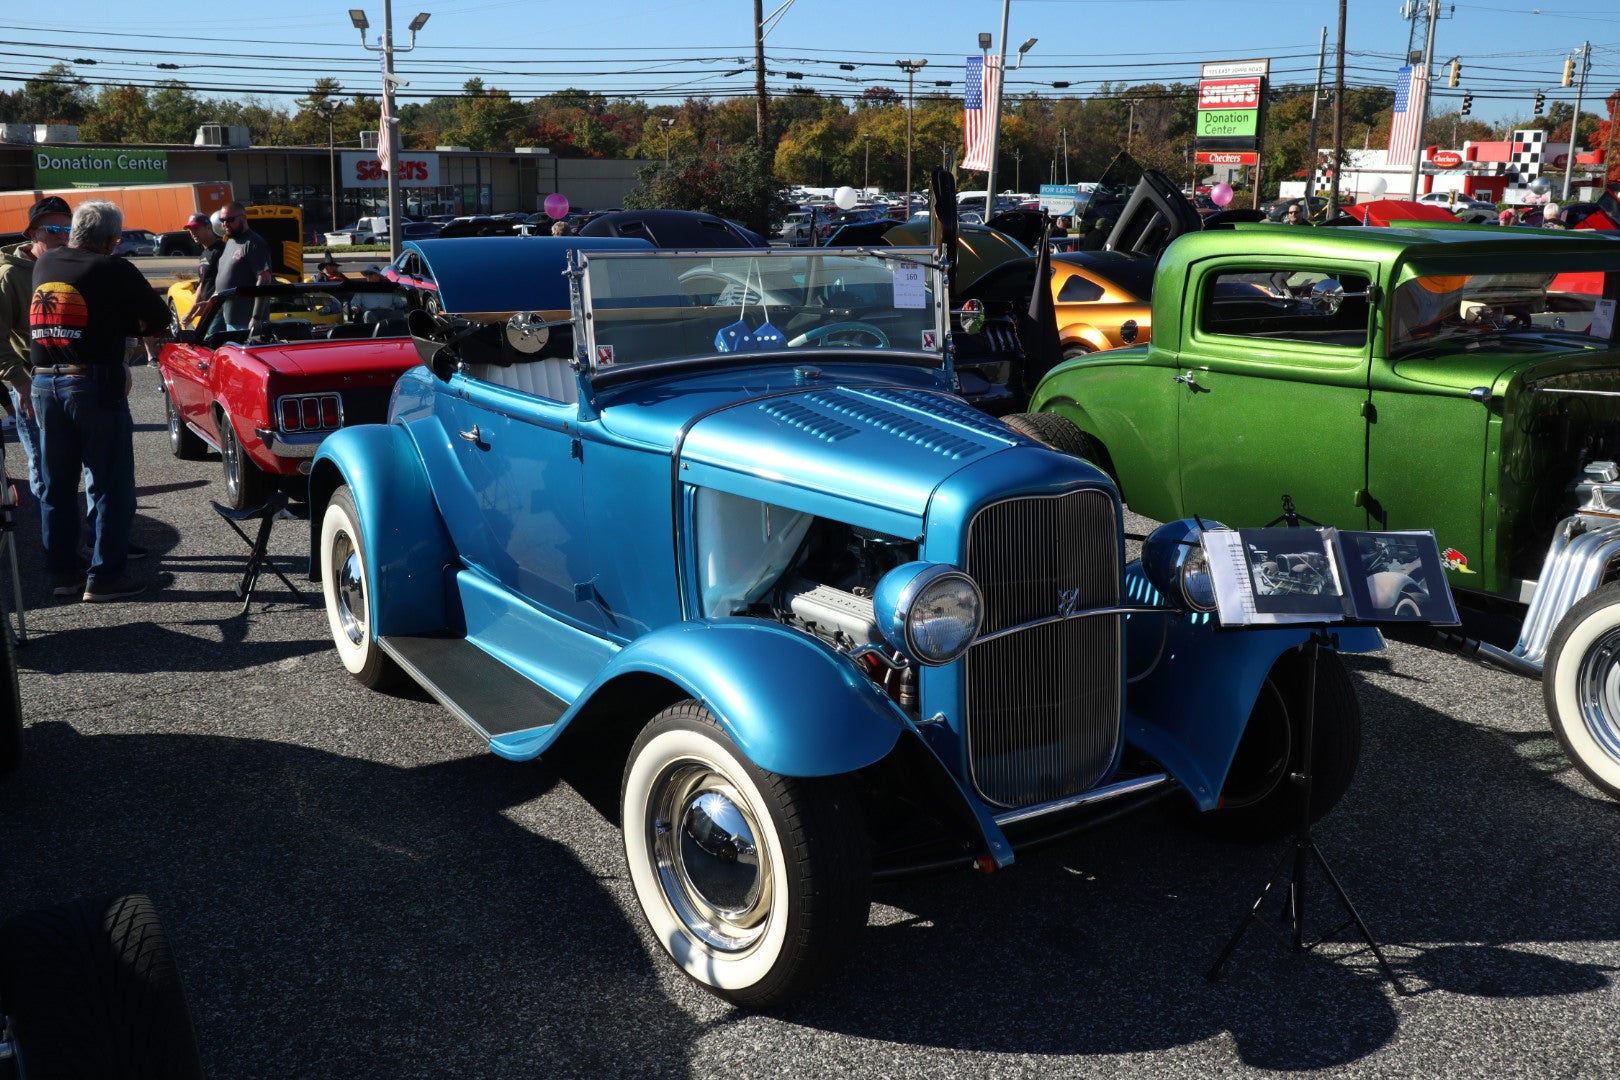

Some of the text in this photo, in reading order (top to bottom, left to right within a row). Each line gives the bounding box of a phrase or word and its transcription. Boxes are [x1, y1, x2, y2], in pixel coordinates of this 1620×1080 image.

[1205, 112, 1249, 123] Donation
[1204, 124, 1237, 134] Center
[37, 153, 168, 170] Donation Center
[1209, 152, 1241, 163] Checkers
[1434, 155, 1458, 163] Checkers
[356, 160, 429, 181] saers
[906, 273, 918, 281] 160
